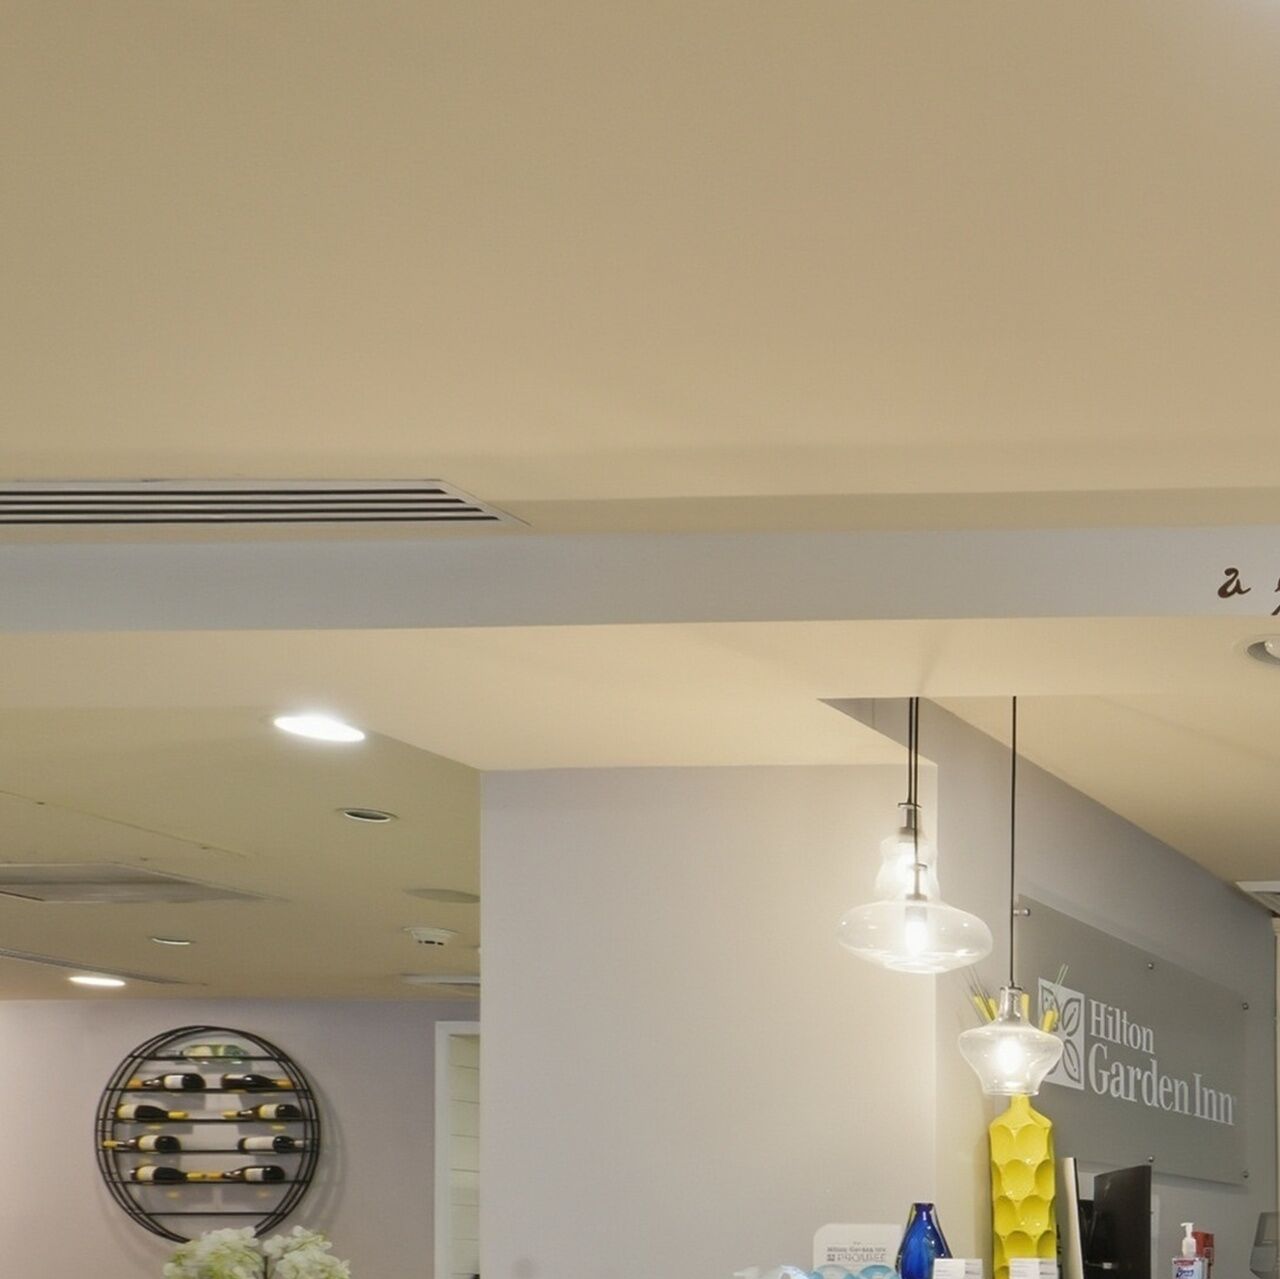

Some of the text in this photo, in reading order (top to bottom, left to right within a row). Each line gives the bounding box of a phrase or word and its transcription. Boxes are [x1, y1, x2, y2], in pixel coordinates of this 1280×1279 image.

[1217, 567, 1252, 599] a
[1089, 998, 1156, 1054] Hilton
[1088, 1043, 1235, 1126] Garden Inn
